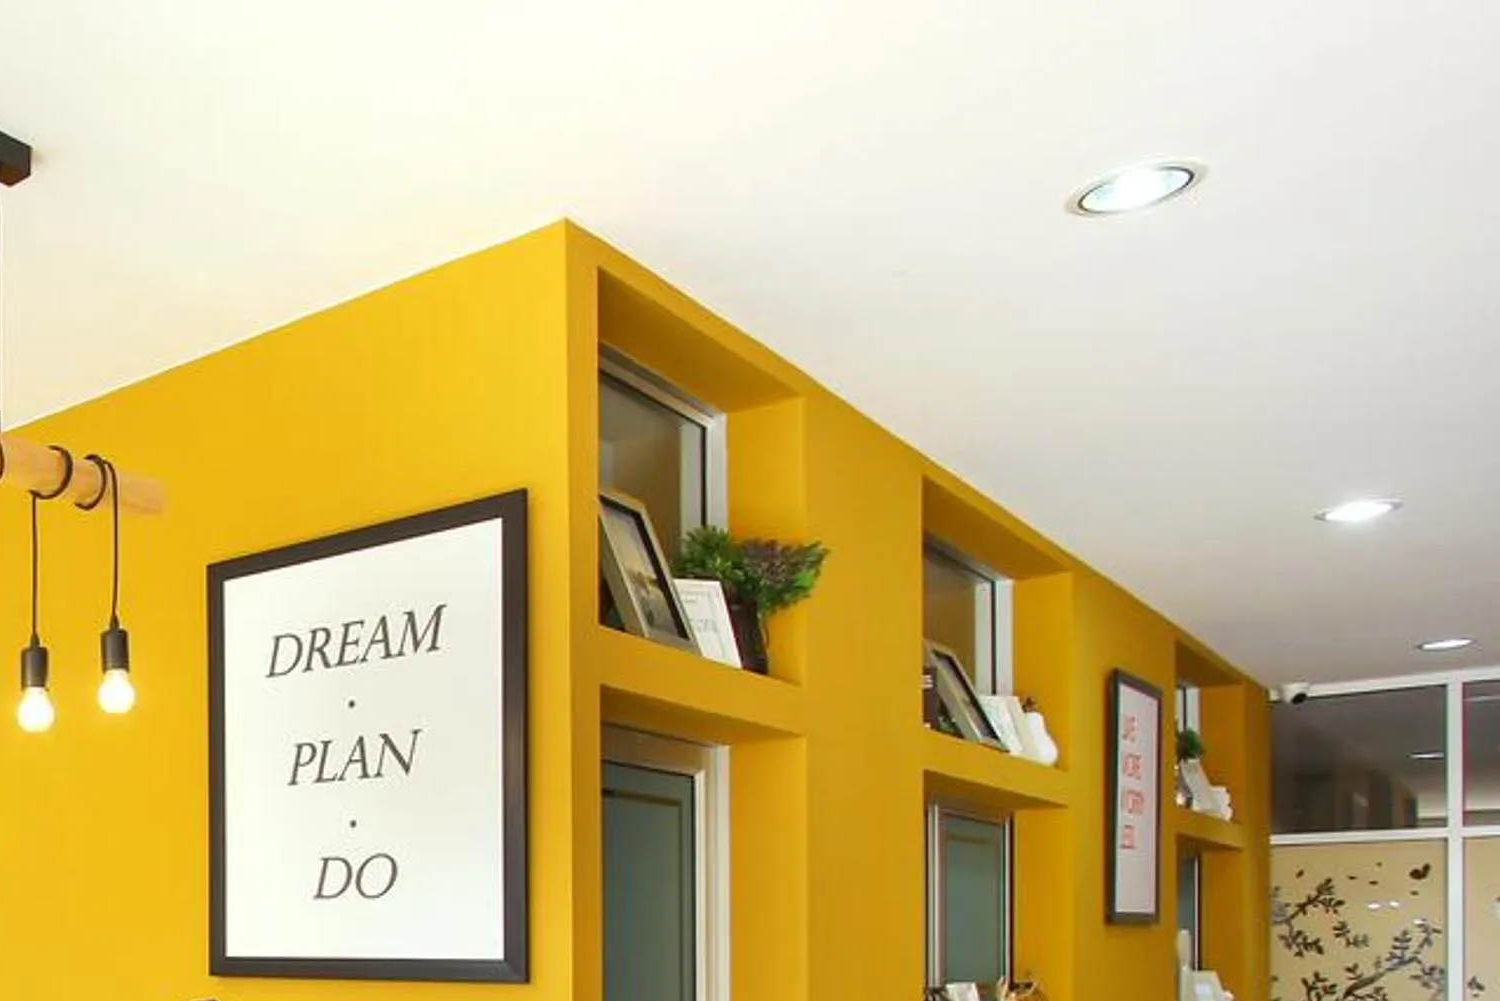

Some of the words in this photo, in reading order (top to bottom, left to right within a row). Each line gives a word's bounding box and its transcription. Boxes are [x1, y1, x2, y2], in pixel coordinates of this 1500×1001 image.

[266, 603, 449, 680] DREAM
[287, 728, 424, 787] PLAN
[312, 852, 400, 901] DO
